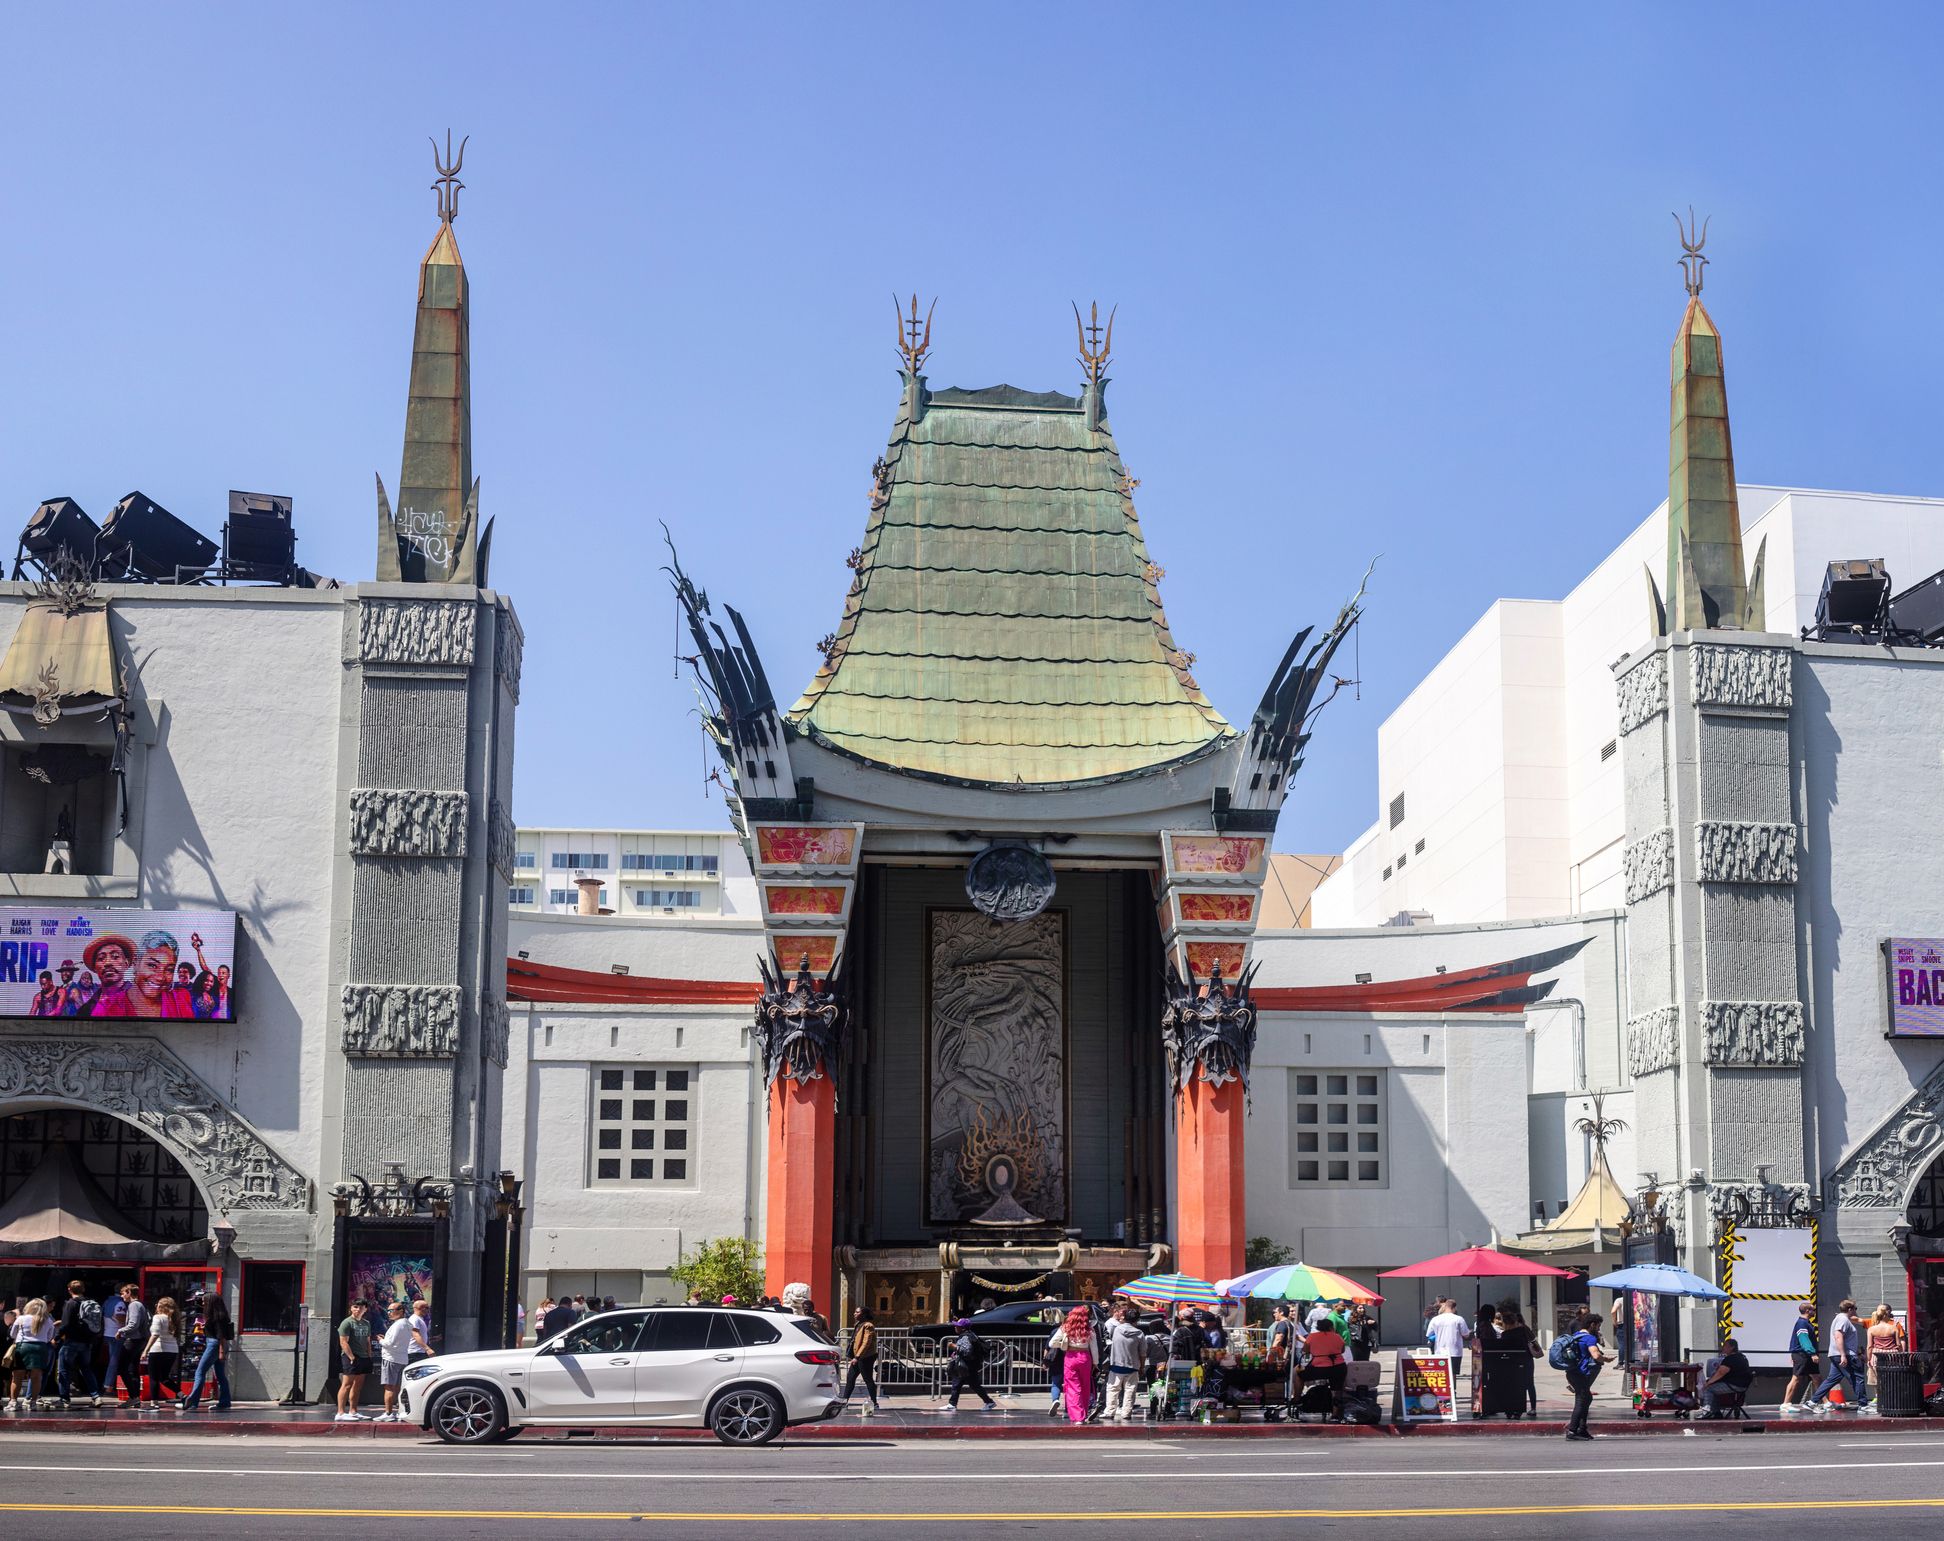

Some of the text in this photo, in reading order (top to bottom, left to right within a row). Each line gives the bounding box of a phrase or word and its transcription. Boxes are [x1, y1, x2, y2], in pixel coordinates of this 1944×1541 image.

[10, 927, 32, 935] HARRIS
[42, 927, 57, 935] LOVE
[66, 927, 93, 936] HADDISH
[0, 941, 48, 983] RIP
[352, 1259, 431, 1285] IMAX
[1407, 1377, 1446, 1387] HERE
